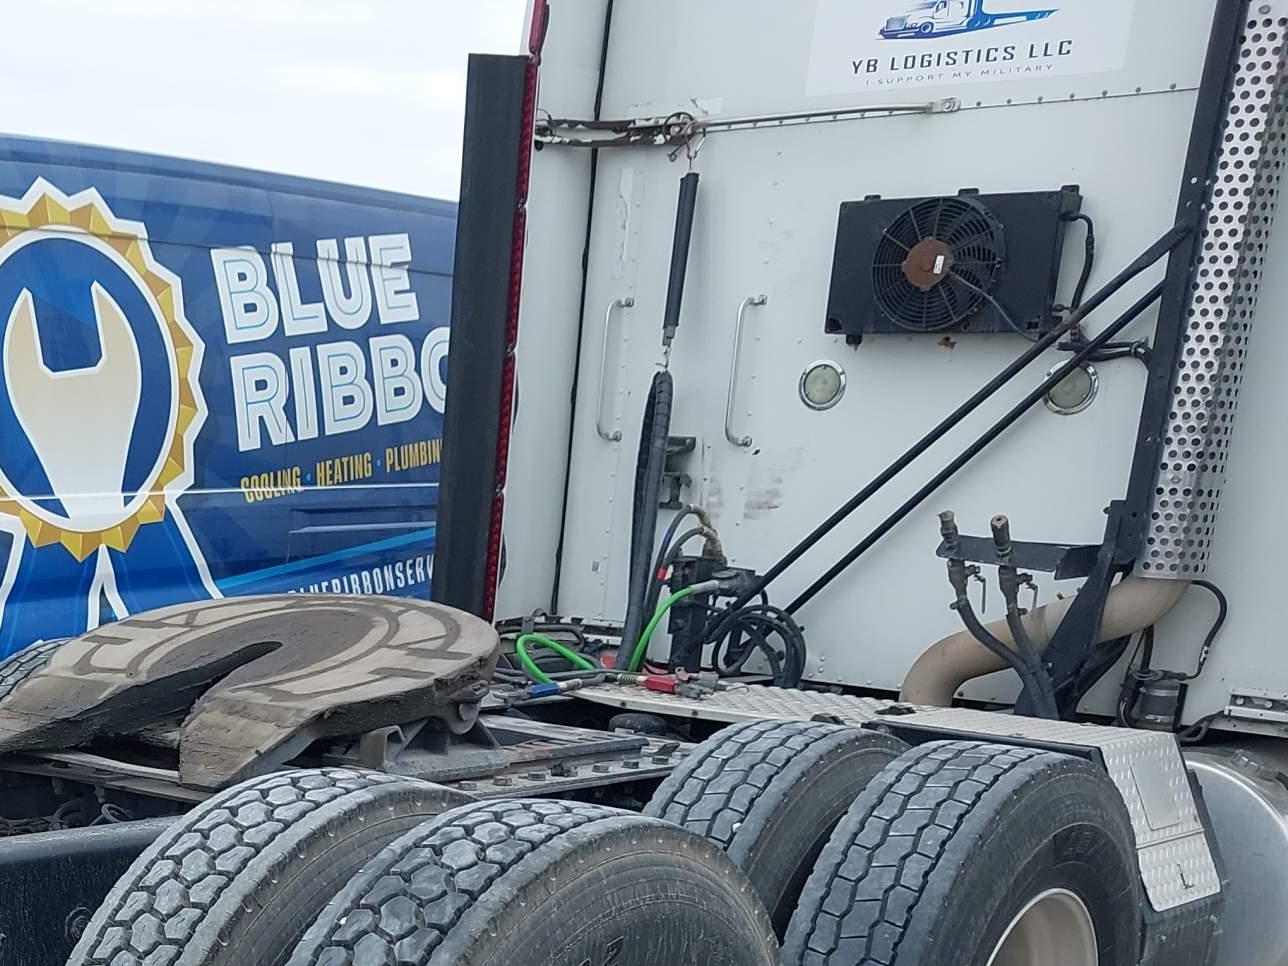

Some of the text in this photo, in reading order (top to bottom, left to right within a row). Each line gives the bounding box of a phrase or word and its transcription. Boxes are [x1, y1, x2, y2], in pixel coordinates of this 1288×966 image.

[850, 39, 1074, 75] YB LOGISTICS LLC
[877, 73, 945, 86] SUPPORT
[952, 70, 974, 79] MY
[980, 63, 1056, 77] MILITARY
[210, 232, 421, 345] BLUE
[240, 438, 444, 504] COOLING HEATING PLUMBIN
